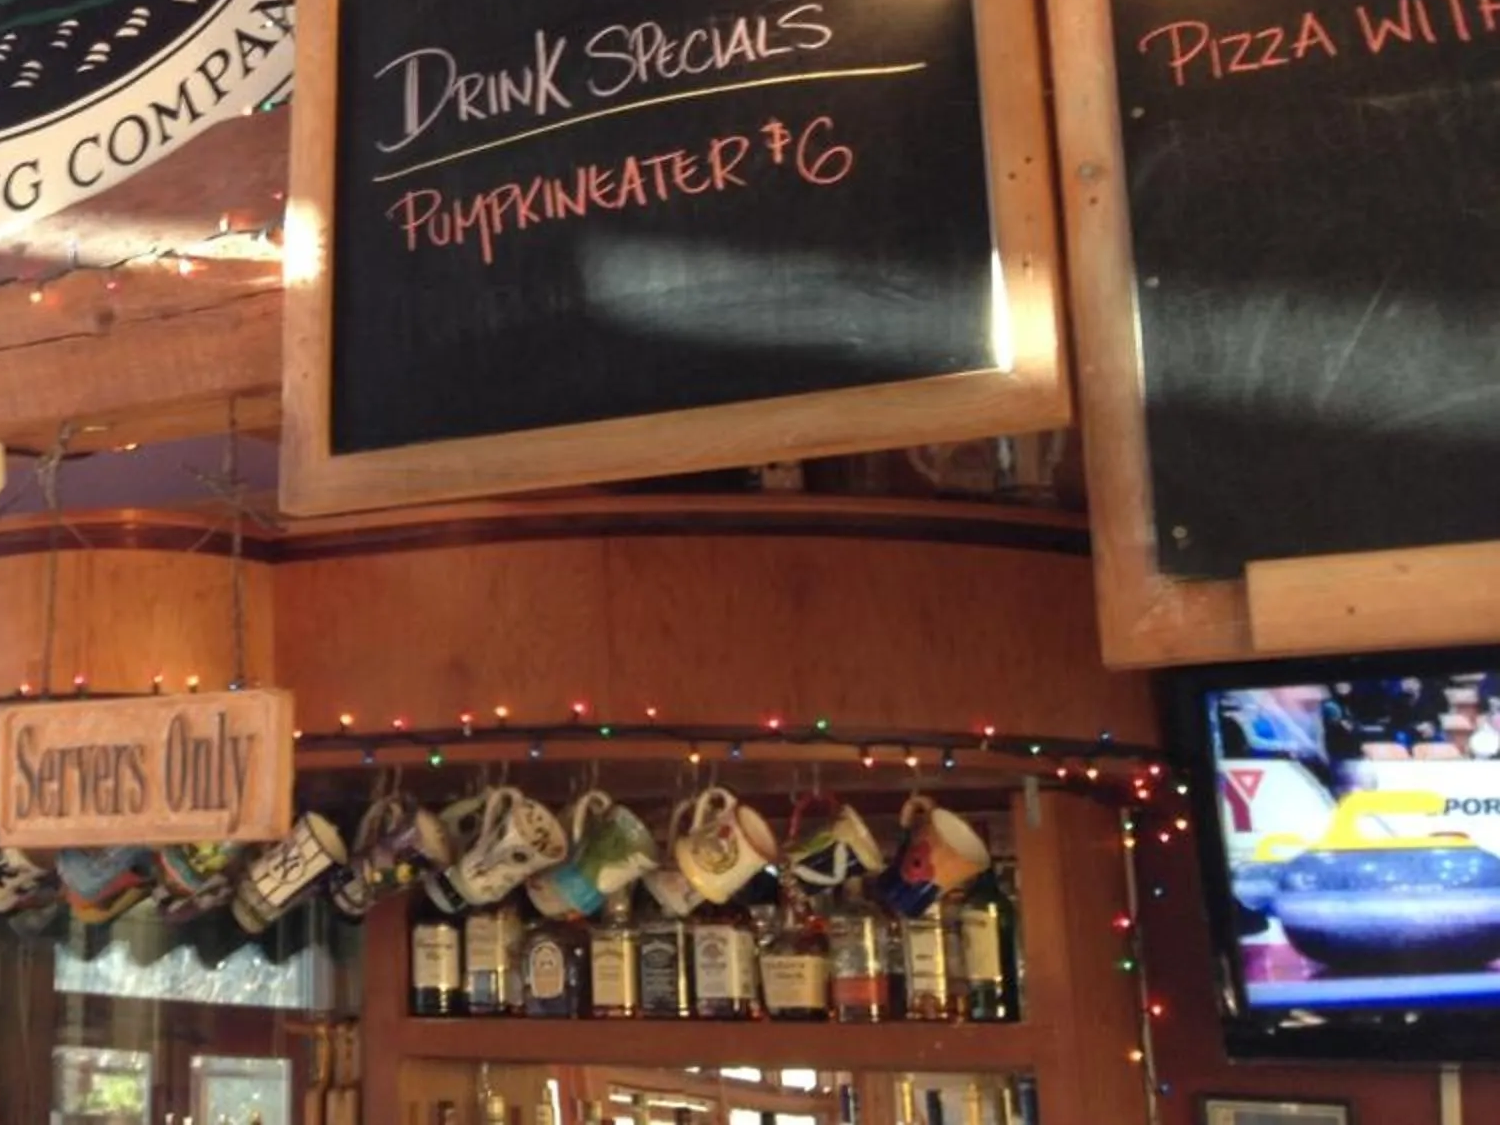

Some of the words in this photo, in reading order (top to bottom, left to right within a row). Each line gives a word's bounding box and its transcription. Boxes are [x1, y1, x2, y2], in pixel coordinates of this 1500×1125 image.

[374, 29, 570, 152] DRINK
[585, 3, 833, 97] SPECIALS
[1138, 12, 1337, 86] PIZZA
[385, 134, 751, 265] PUMPKINEATER
[763, 117, 854, 184] $6
[15, 723, 146, 820] Servers
[163, 712, 255, 832] Only
